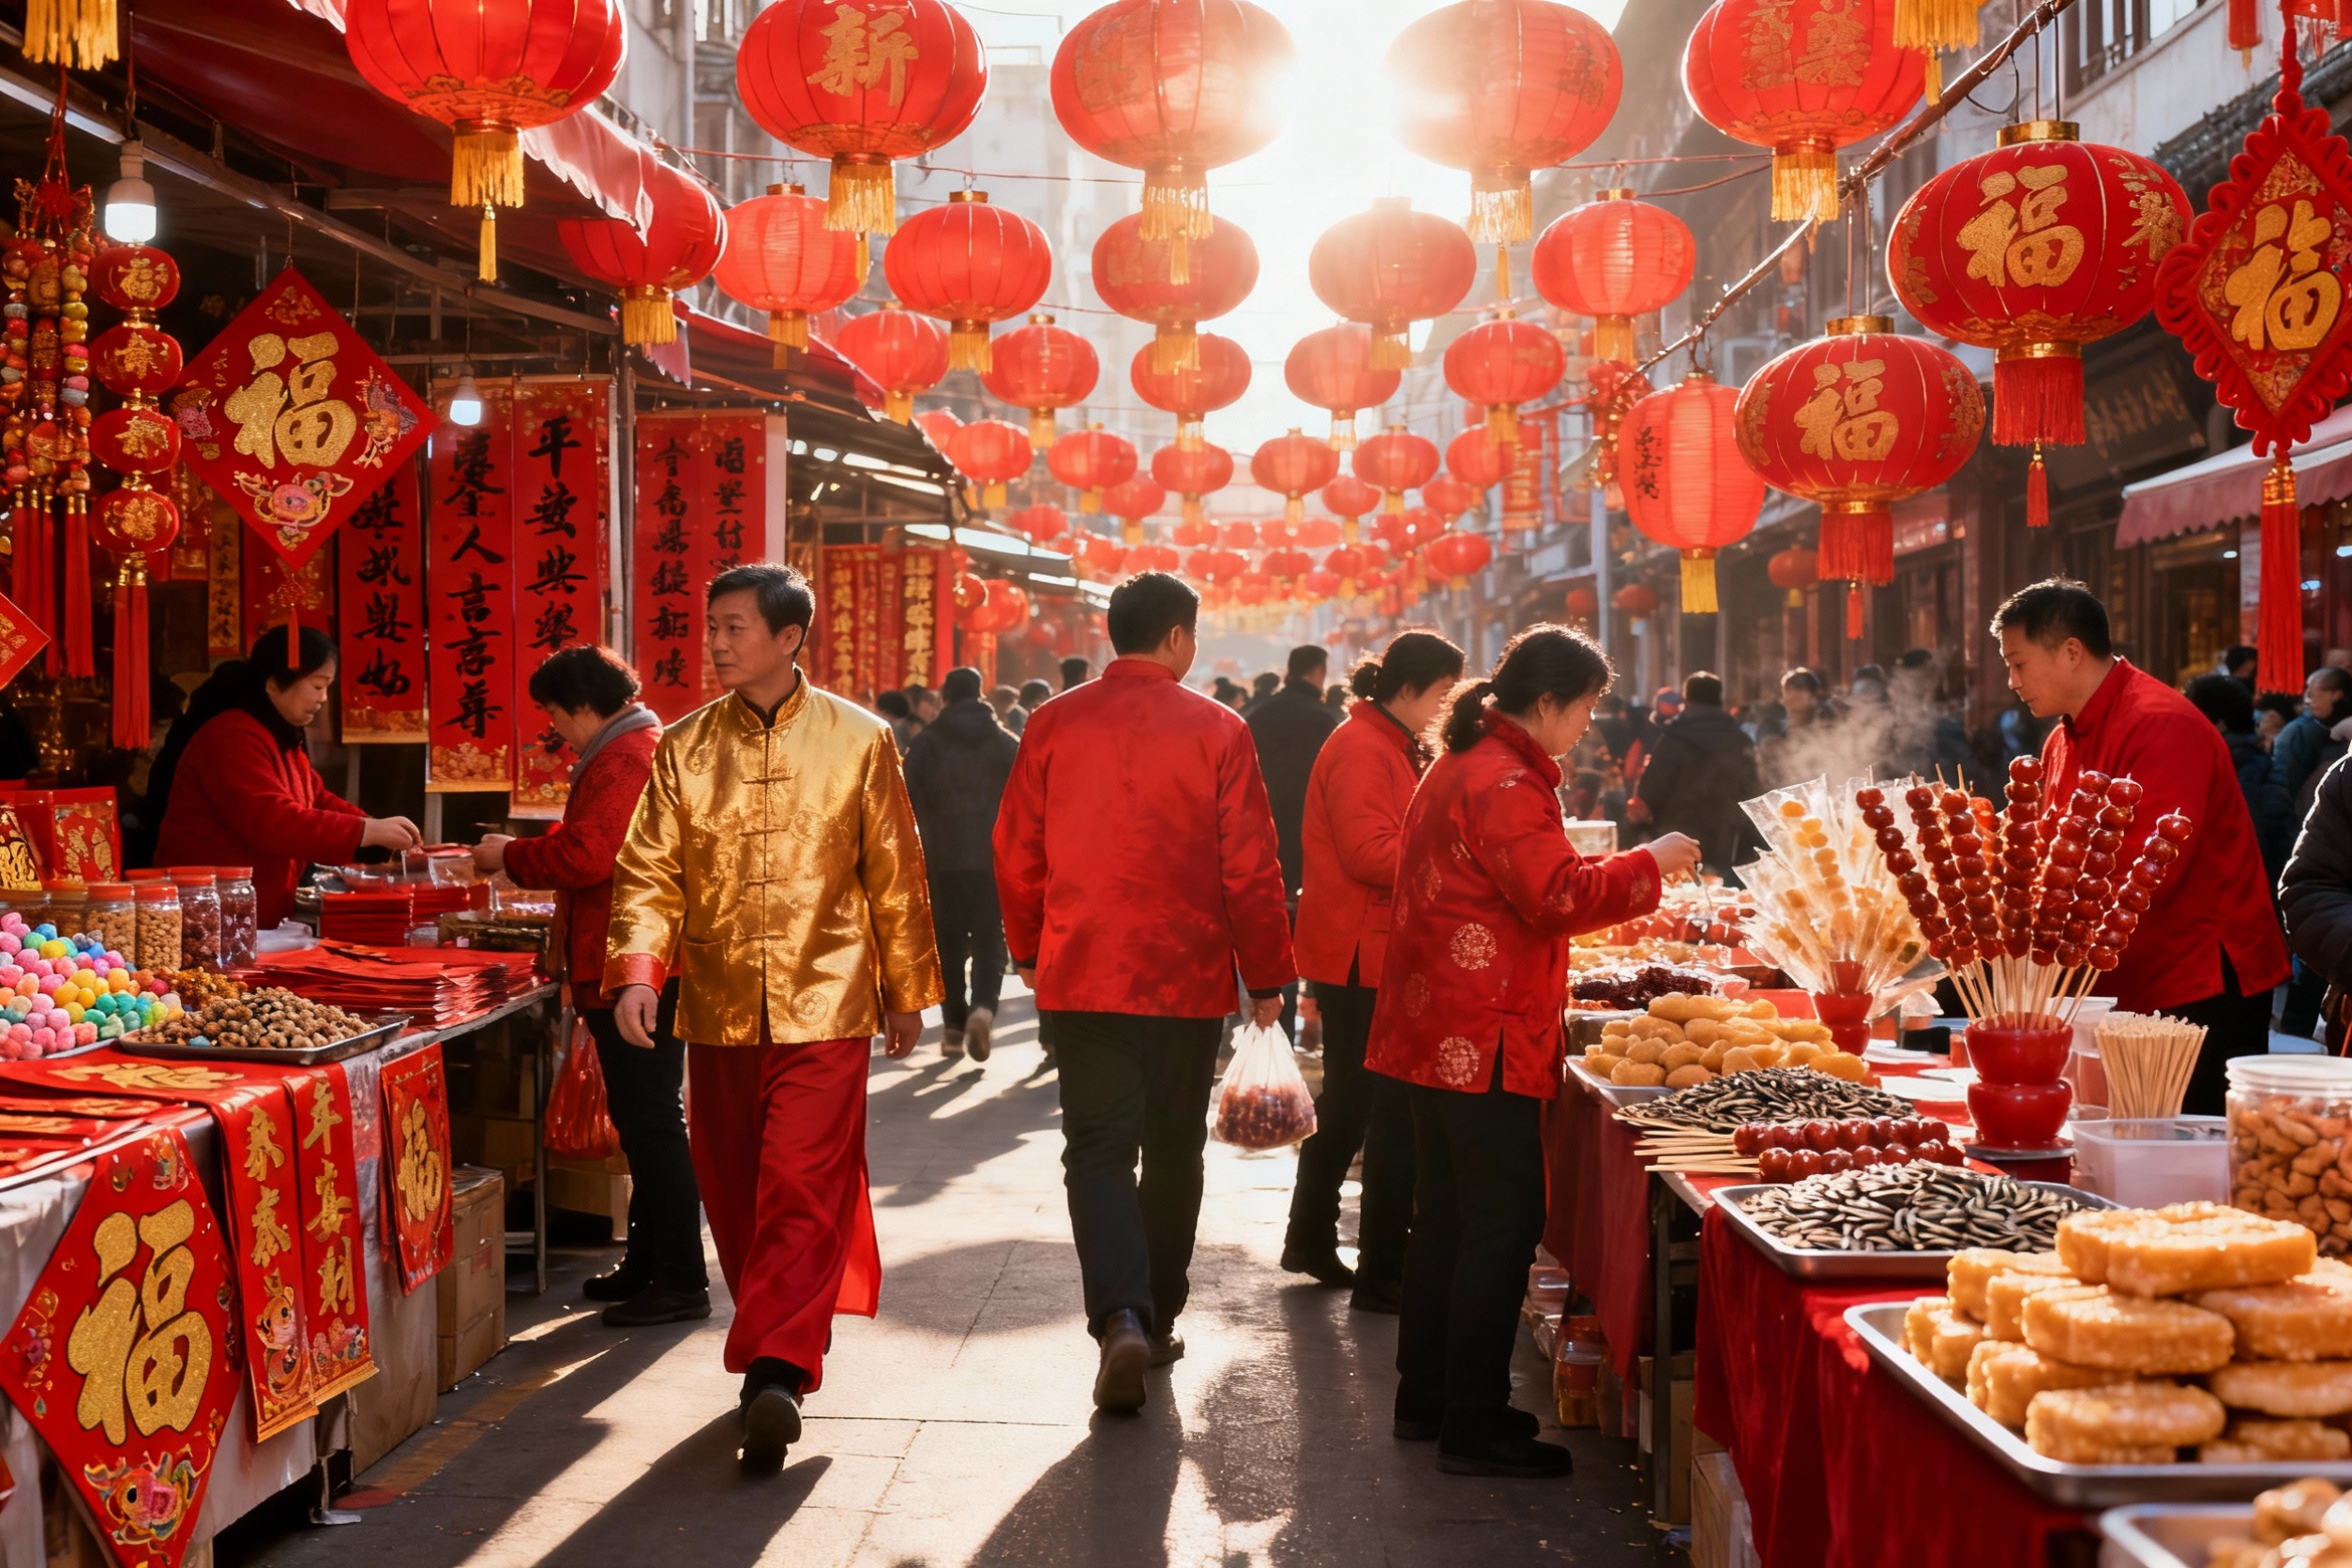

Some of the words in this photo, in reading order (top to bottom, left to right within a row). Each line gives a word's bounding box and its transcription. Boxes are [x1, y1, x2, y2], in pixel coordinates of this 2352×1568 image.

[807, 4, 919, 108] 新
[1956, 164, 2085, 288] 福
[224, 332, 357, 469] 福
[1793, 358, 1900, 461] 福
[68, 1199, 212, 1445] 福
